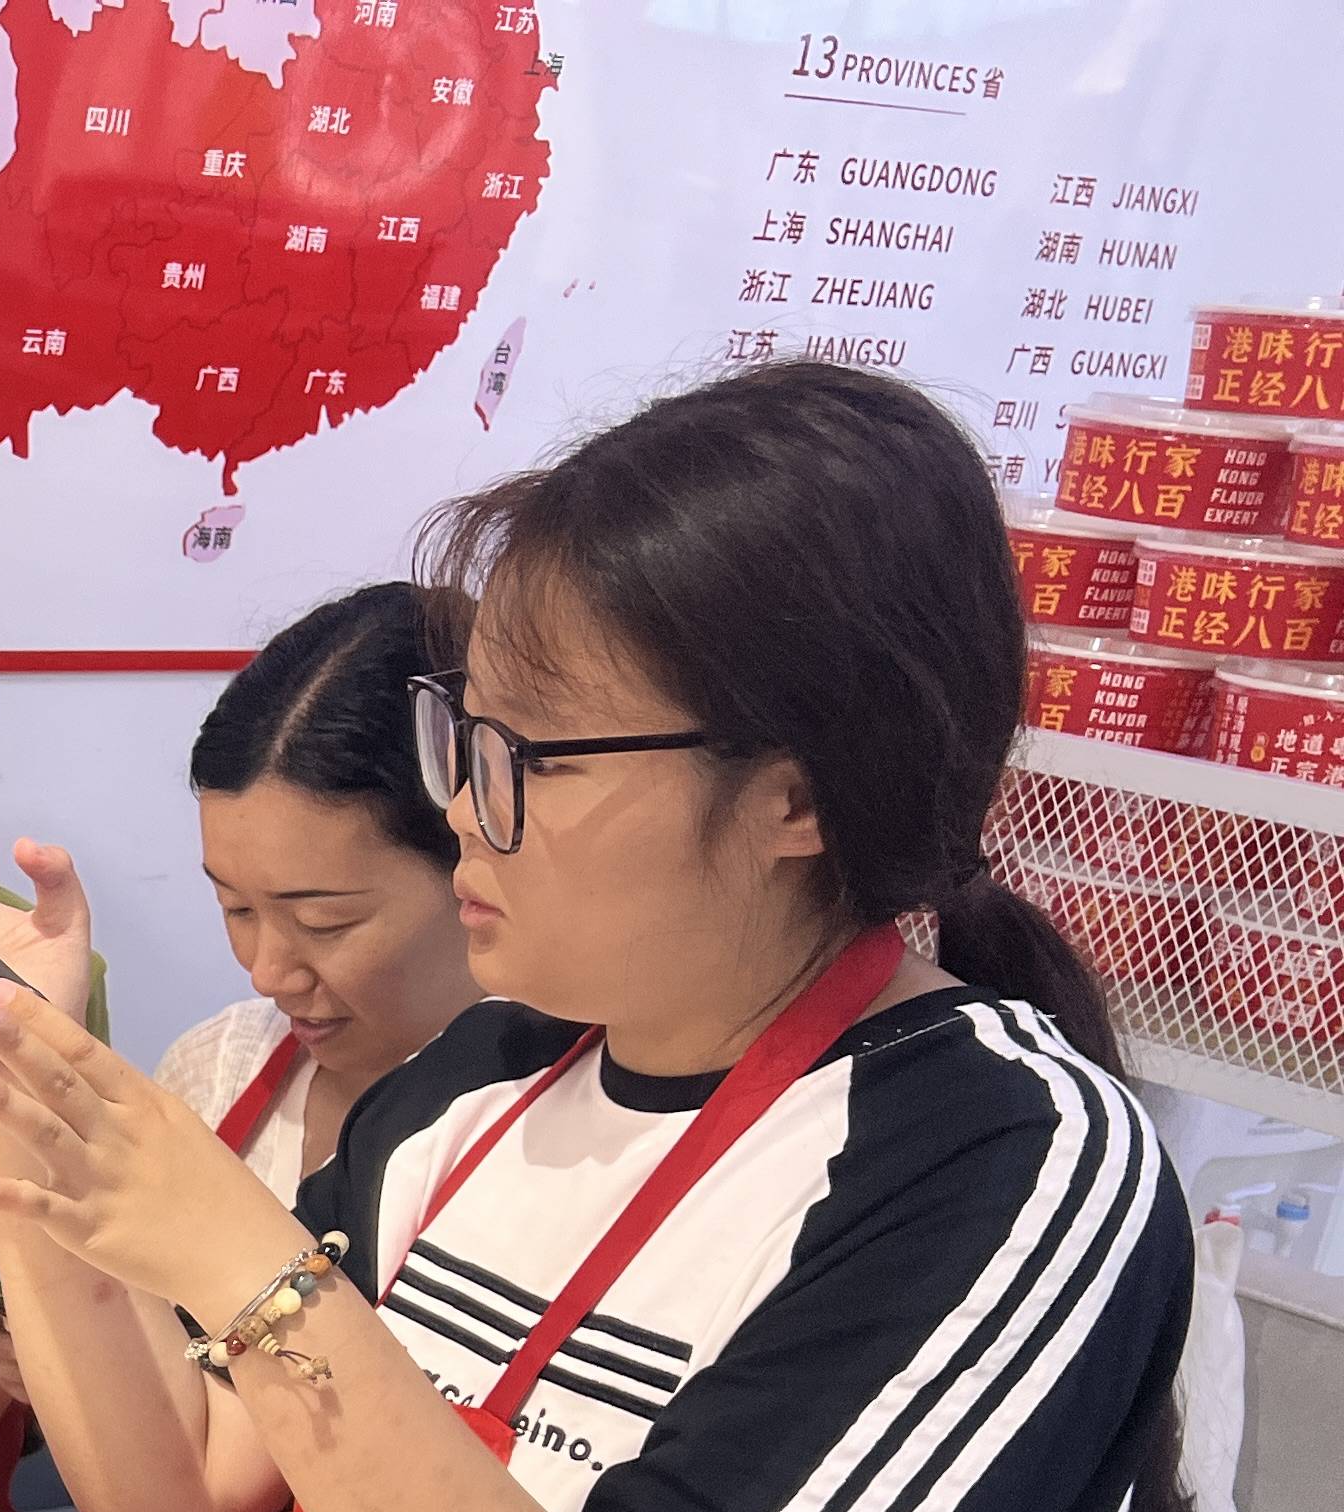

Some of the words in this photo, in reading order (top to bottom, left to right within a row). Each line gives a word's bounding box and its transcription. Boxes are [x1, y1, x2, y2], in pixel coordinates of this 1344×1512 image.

[353, 1, 398, 28] 河南
[494, 5, 536, 35] 江苏
[524, 51, 565, 76] 上海
[431, 77, 475, 106] 安徽
[85, 106, 130, 137] 四川
[307, 105, 352, 135] 湖北
[201, 149, 248, 178] 重庆
[766, 148, 818, 185] 广东
[840, 156, 999, 198] GUANGDONG
[482, 172, 523, 200] 浙江
[1051, 174, 1097, 208] 江西
[1112, 181, 1200, 217] JIANGXI
[284, 225, 328, 253] 湖南
[377, 215, 421, 243] 江西
[753, 209, 806, 246] 上海
[825, 217, 954, 254] SHANGHAI
[1034, 231, 1084, 265] 湖南
[1098, 239, 1178, 271] HUNAN
[161, 262, 206, 290] 贵州
[420, 284, 461, 311] 福建
[738, 269, 789, 305] 浙江
[811, 276, 935, 312] ZHEJIANG
[1020, 288, 1066, 322] 湖北
[1084, 296, 1154, 326] HUBEI
[22, 328, 67, 356] 云南
[725, 329, 778, 363] 江苏
[1006, 344, 1052, 376] 广西
[1070, 351, 1168, 381] GUANGXI
[195, 365, 240, 392] 广西
[304, 369, 347, 395] 广东
[1213, 369, 1344, 412] 正经八
[993, 400, 1039, 430] 四川
[1211, 488, 1265, 506] FLAVOR
[1204, 508, 1259, 527] EXPERT
[190, 526, 233, 551] 海南
[1166, 565, 1330, 612] 港味行家
[1078, 605, 1129, 620] EXPERT
[1157, 606, 1314, 651] 正经八百
[1100, 672, 1146, 690] HONG
[1094, 690, 1139, 709] KONG
[1088, 708, 1148, 728] FLAVOR
